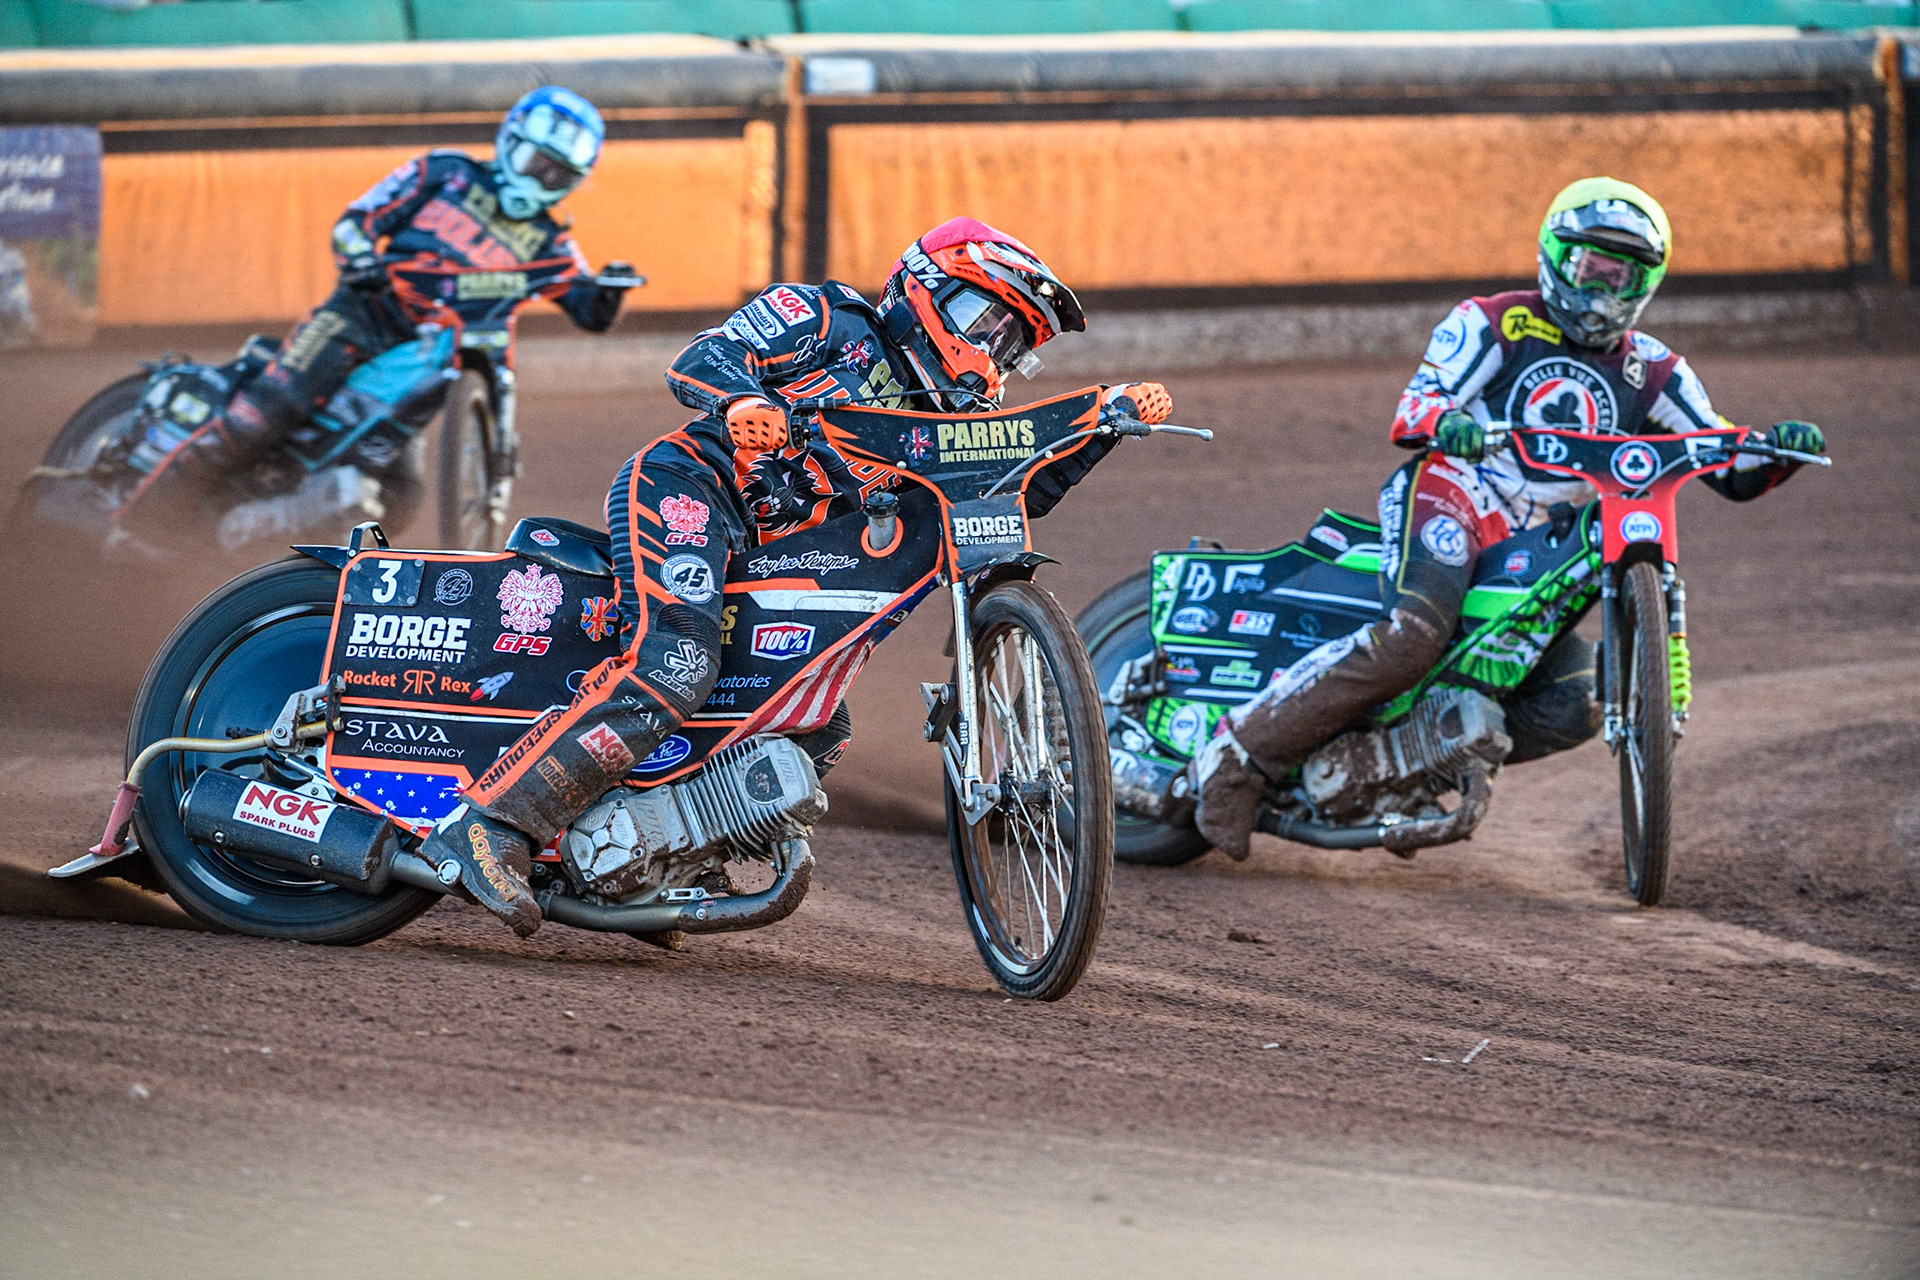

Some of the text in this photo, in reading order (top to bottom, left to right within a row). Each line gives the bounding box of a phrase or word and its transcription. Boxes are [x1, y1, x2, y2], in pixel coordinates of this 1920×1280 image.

[1523, 364, 1611, 427] BELLE VUE ACES
[937, 419, 1036, 450] PARRYS
[953, 515, 1022, 537] BORGE
[665, 532, 709, 547] GPS
[956, 536, 1023, 545] DEVELOPMENT
[799, 550, 859, 576] Designs
[372, 560, 402, 604] 3
[674, 567, 708, 587] 45
[349, 613, 472, 651] BORGE
[493, 632, 552, 655] GPS
[758, 630, 809, 651] 100%
[345, 645, 466, 664] DEVELOPMENT
[343, 669, 397, 688] Rocket
[441, 676, 471, 693] Rex
[621, 695, 667, 740] STAVA
[345, 719, 450, 744] STAVA
[960, 722, 969, 746] BAR
[243, 785, 329, 826] NGK
[239, 811, 316, 839] SPARK PLUGS
[468, 823, 520, 902] daytona
